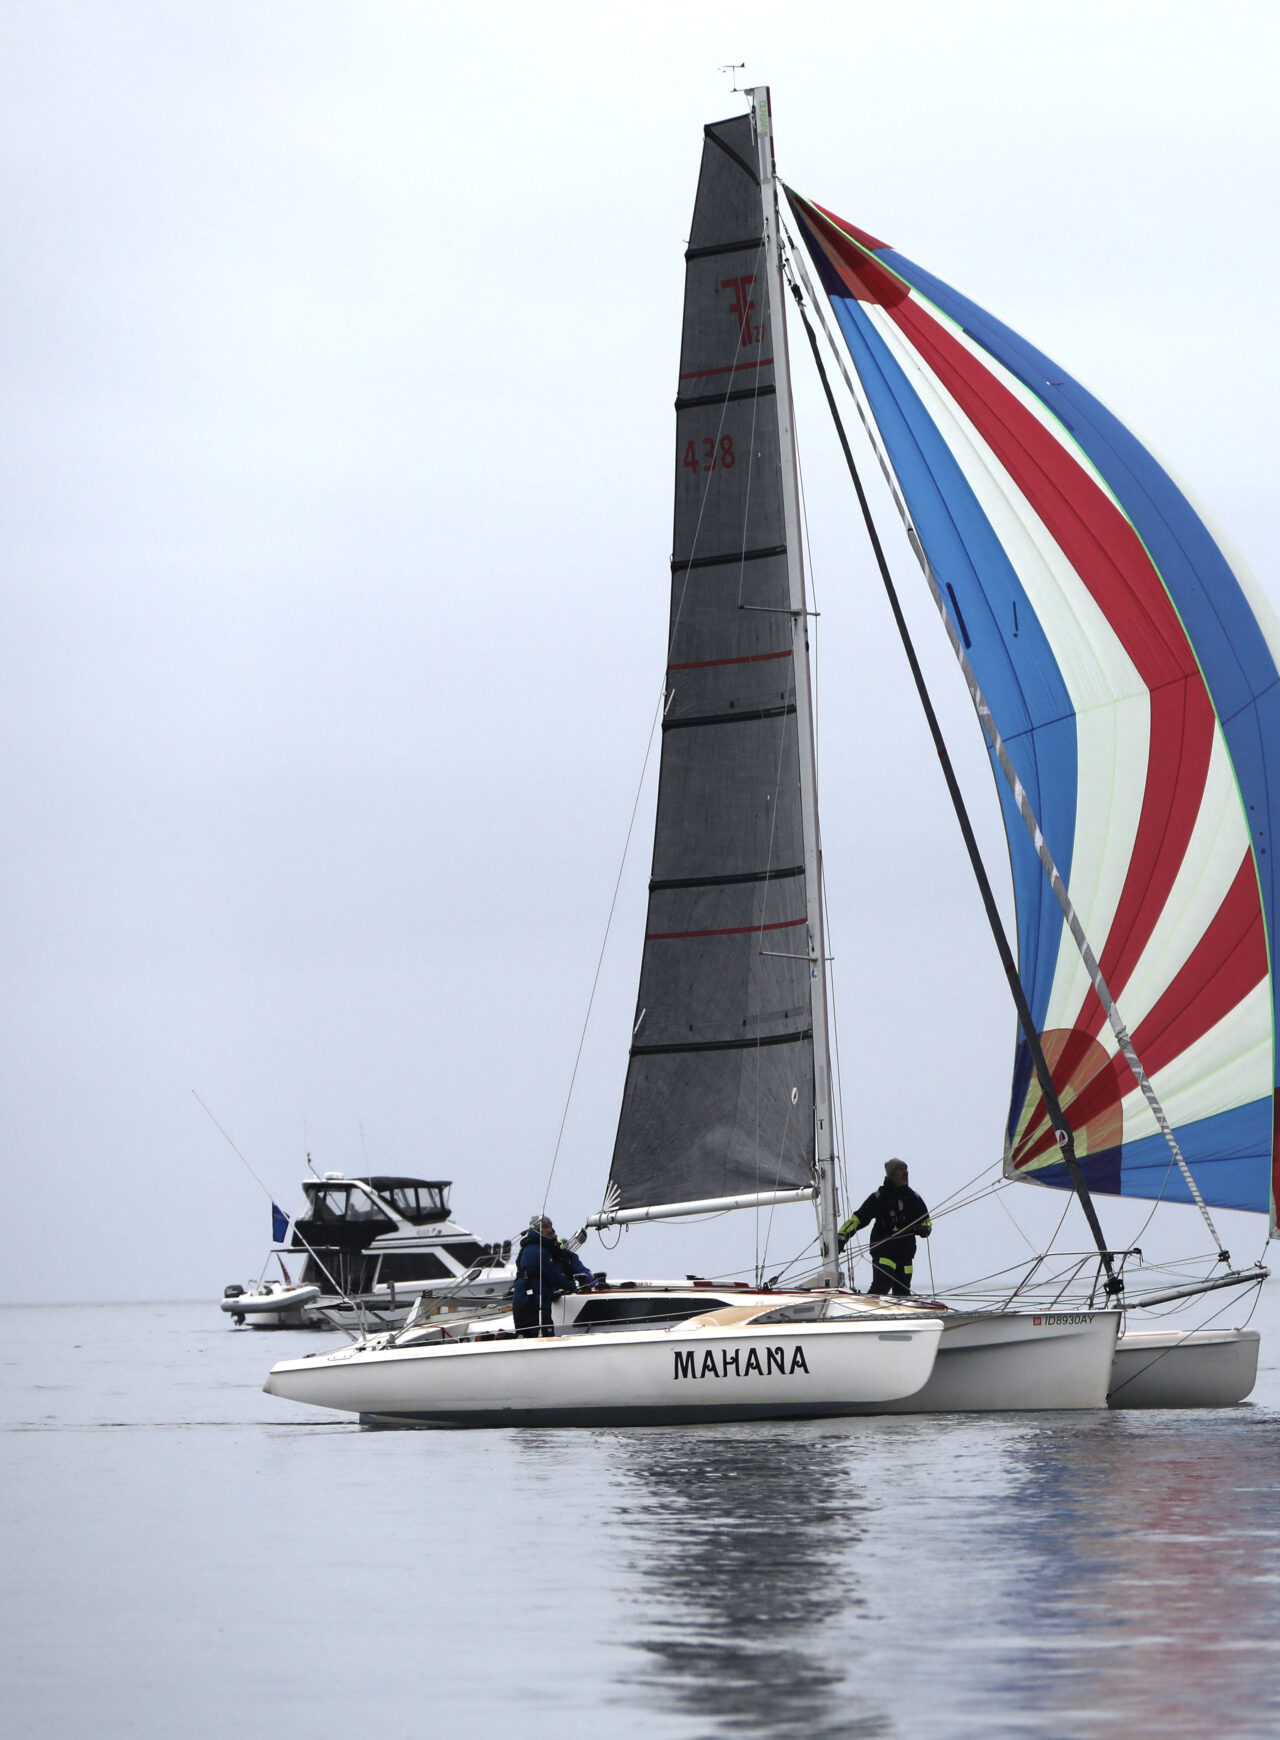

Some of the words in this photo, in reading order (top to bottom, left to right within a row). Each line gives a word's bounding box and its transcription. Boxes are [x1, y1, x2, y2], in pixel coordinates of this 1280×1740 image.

[683, 435, 736, 474] 438
[1045, 1315, 1096, 1326] ID8930AY
[673, 1345, 810, 1380] MAHANA
